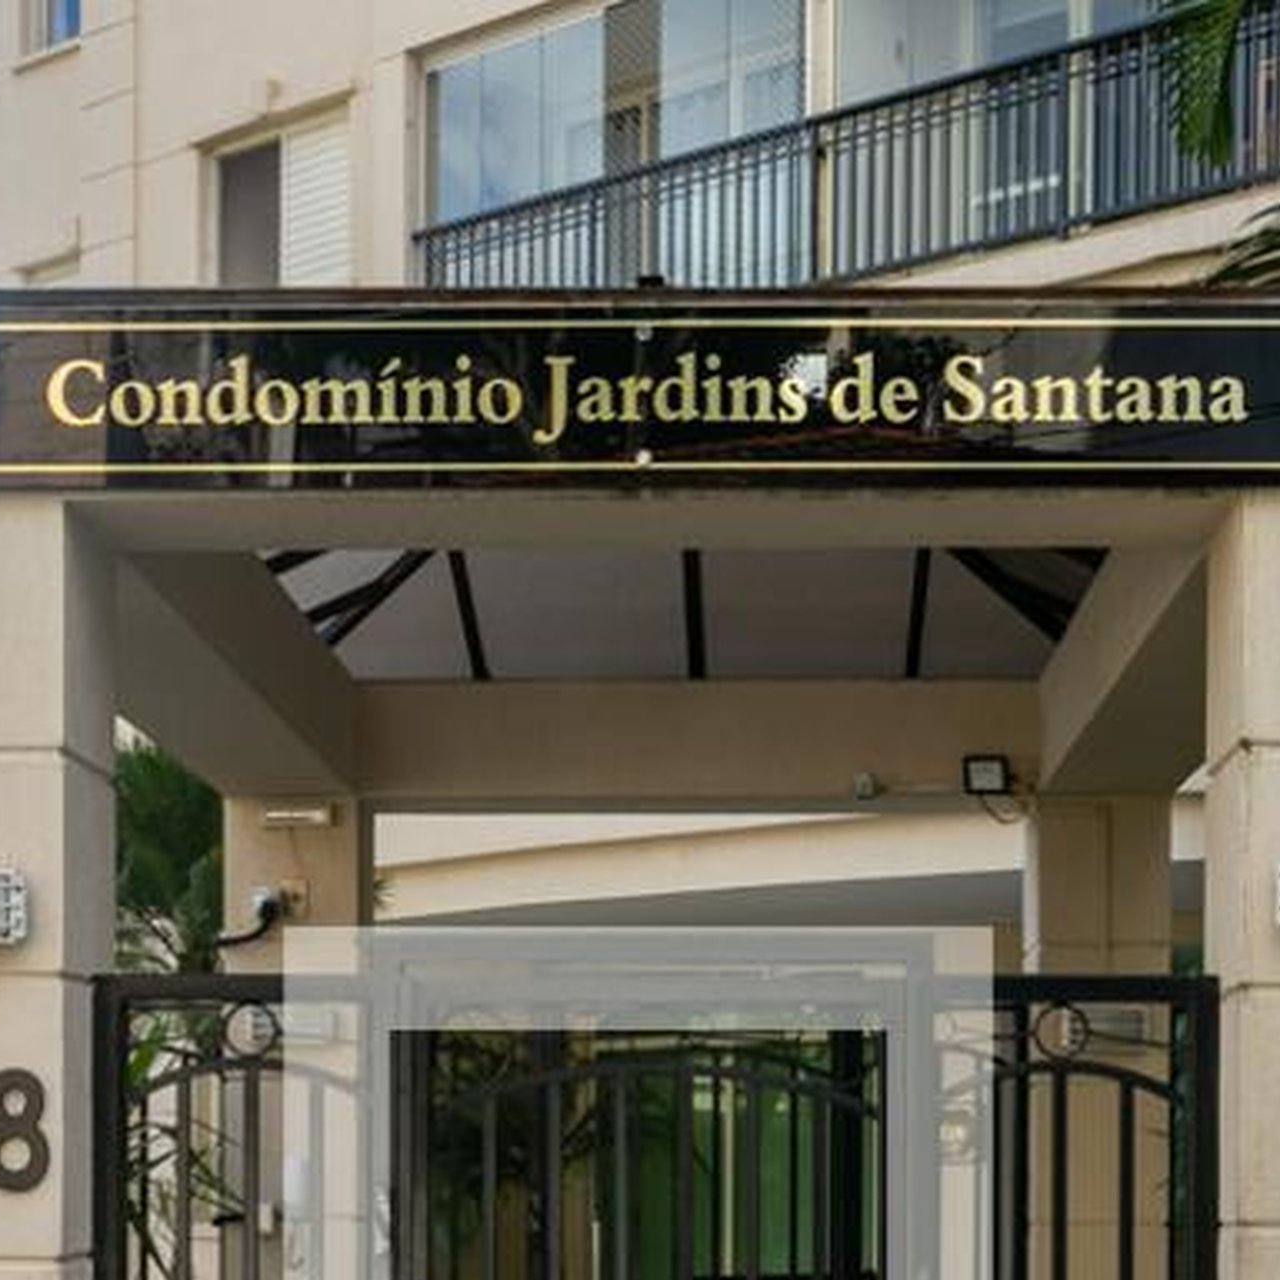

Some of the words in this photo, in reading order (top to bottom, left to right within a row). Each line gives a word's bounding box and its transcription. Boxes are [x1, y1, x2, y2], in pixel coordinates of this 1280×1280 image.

[45, 355, 522, 427] Condomínio
[532, 352, 809, 445] Jardins
[829, 352, 920, 425] de
[942, 355, 1249, 423] Santana
